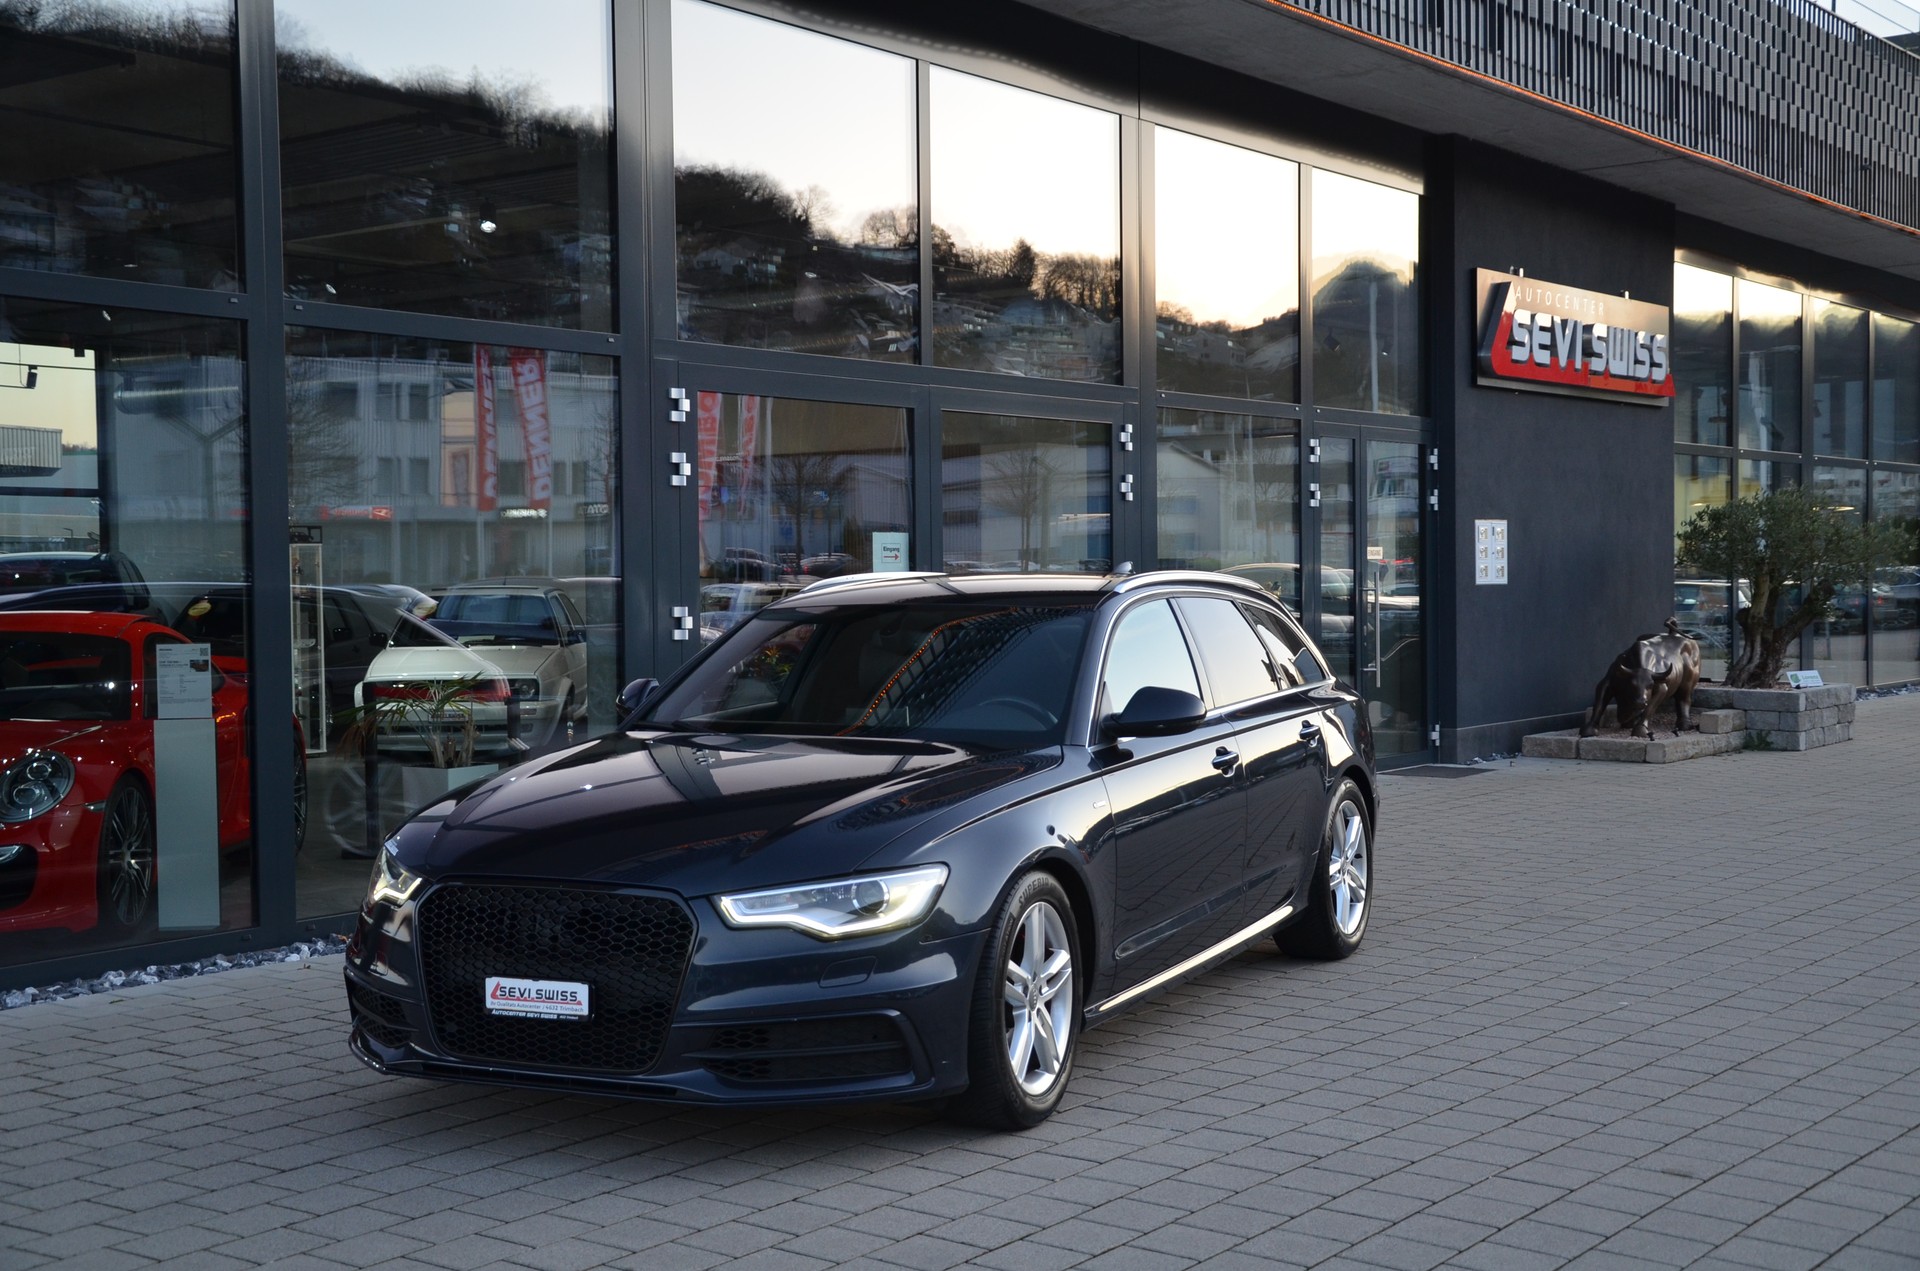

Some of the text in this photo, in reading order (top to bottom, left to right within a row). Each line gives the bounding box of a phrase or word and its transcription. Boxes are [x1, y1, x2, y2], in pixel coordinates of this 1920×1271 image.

[1515, 284, 1605, 316] AUTOCENTER
[1511, 308, 1667, 382] SEVI SWISS
[499, 986, 578, 1002] SEVI SWISS
